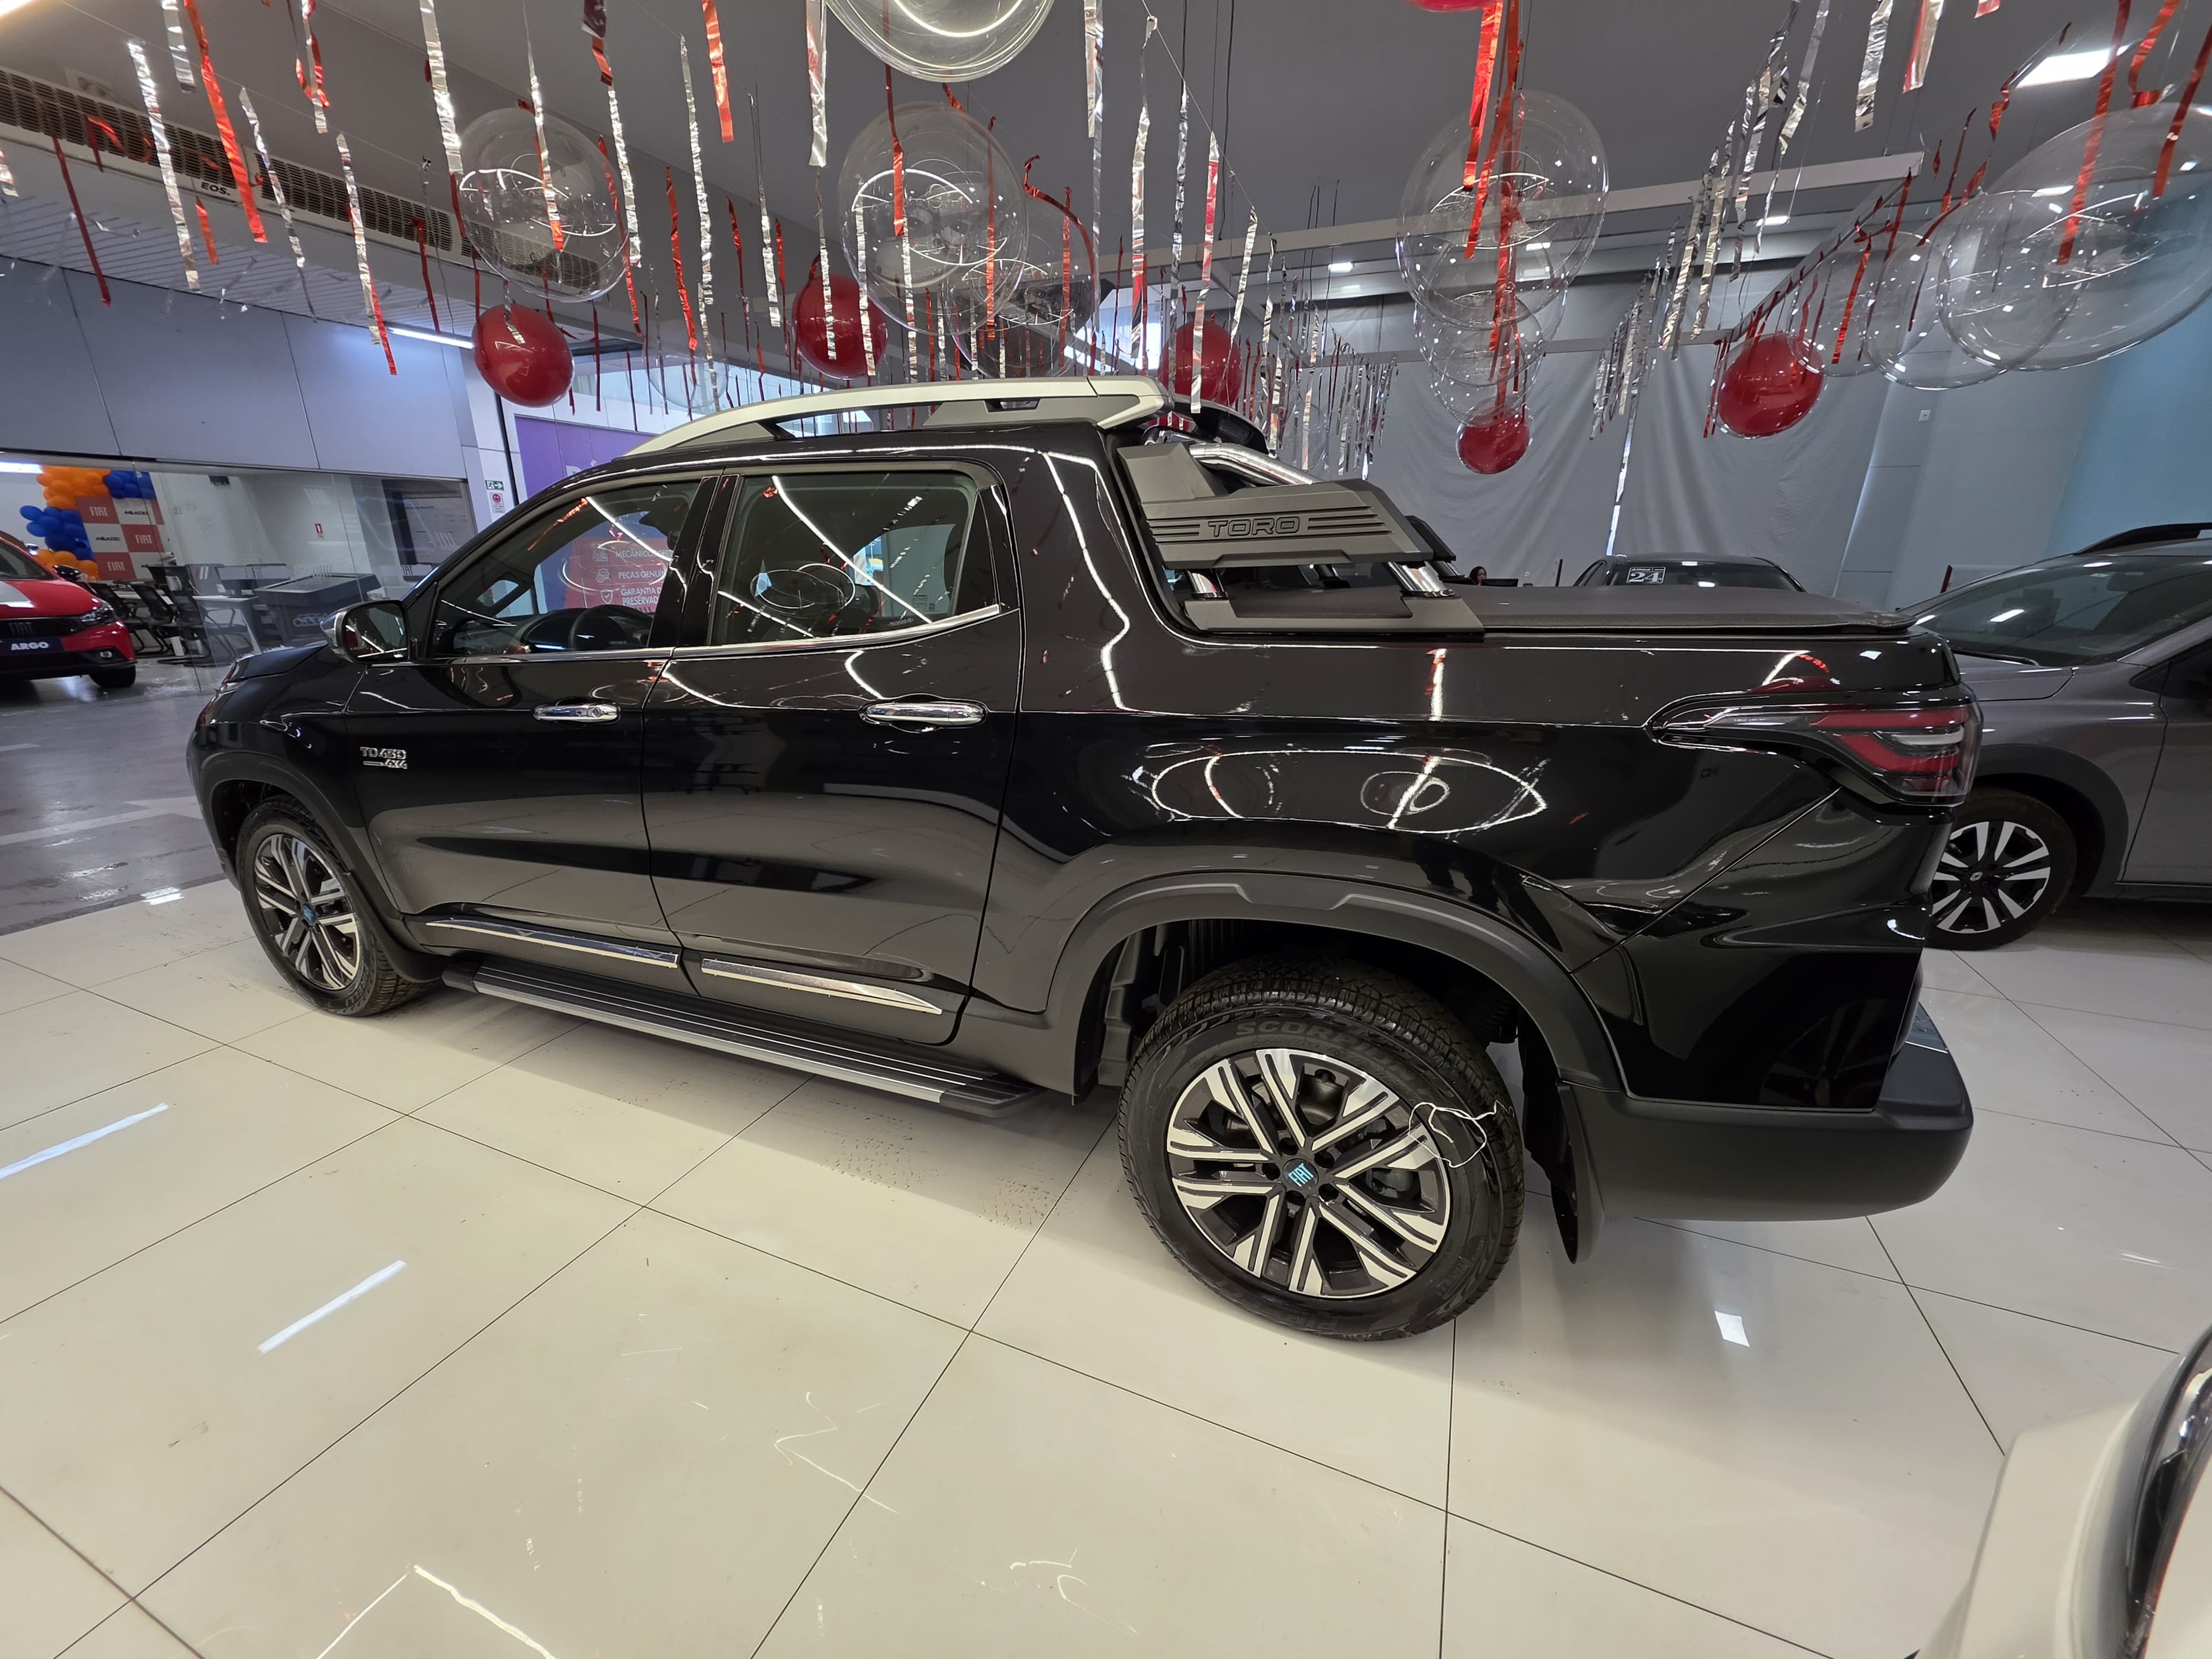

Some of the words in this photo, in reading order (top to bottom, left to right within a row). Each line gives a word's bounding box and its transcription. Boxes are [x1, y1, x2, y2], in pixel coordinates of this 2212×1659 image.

[90, 507, 108, 516] FIAT
[1208, 517, 1300, 537] TORO
[135, 535, 152, 544] FIAT
[107, 562, 125, 571] FIAT
[401, 566, 413, 576] IAT
[1629, 572, 1662, 582] 24
[621, 587, 656, 596] GARANTIA
[9, 622, 33, 635] FIAT
[11, 642, 49, 650] ARGO
[345, 963, 369, 1006] PIRELLI
[1288, 1162, 1314, 1187] FIAT
